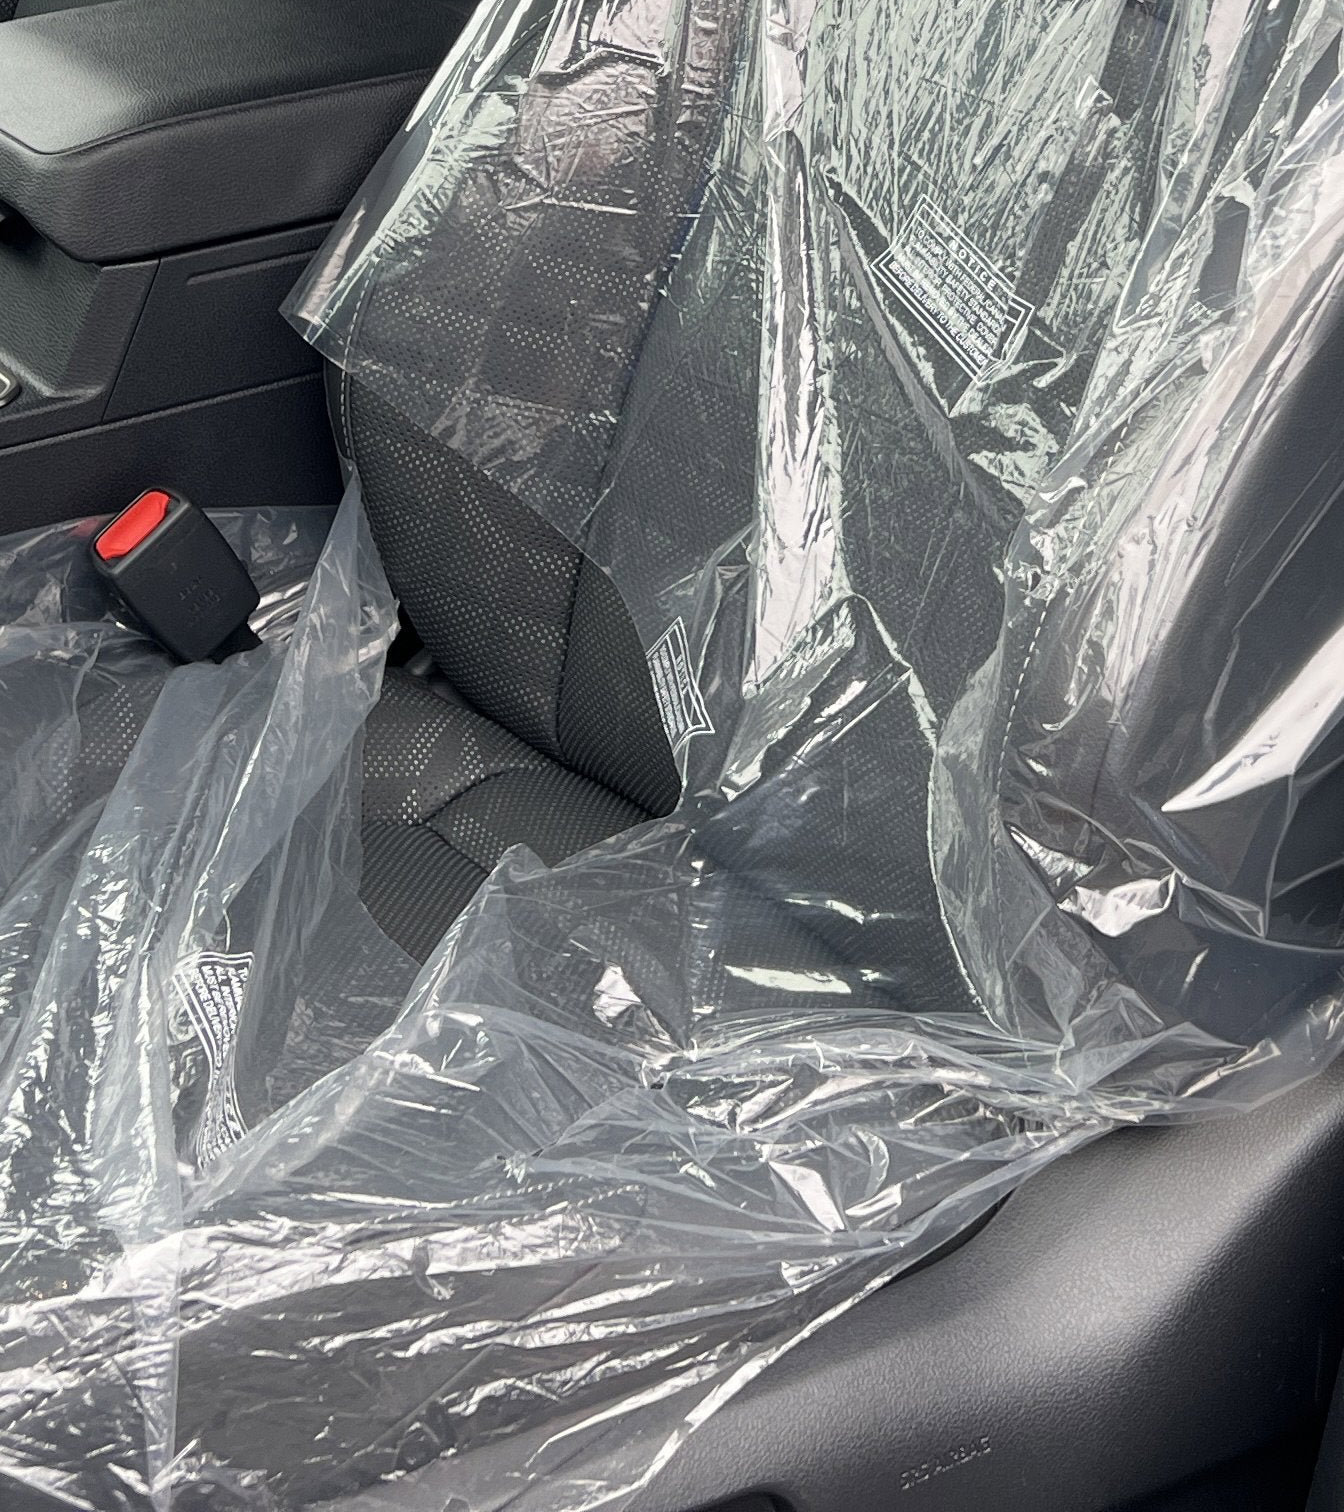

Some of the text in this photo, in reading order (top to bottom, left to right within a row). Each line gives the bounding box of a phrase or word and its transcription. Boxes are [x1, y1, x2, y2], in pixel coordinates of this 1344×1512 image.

[949, 239, 998, 291] NOTICE
[888, 260, 914, 289] BEFORE
[945, 319, 960, 336] THE
[940, 285, 978, 325] PROTECTIVE
